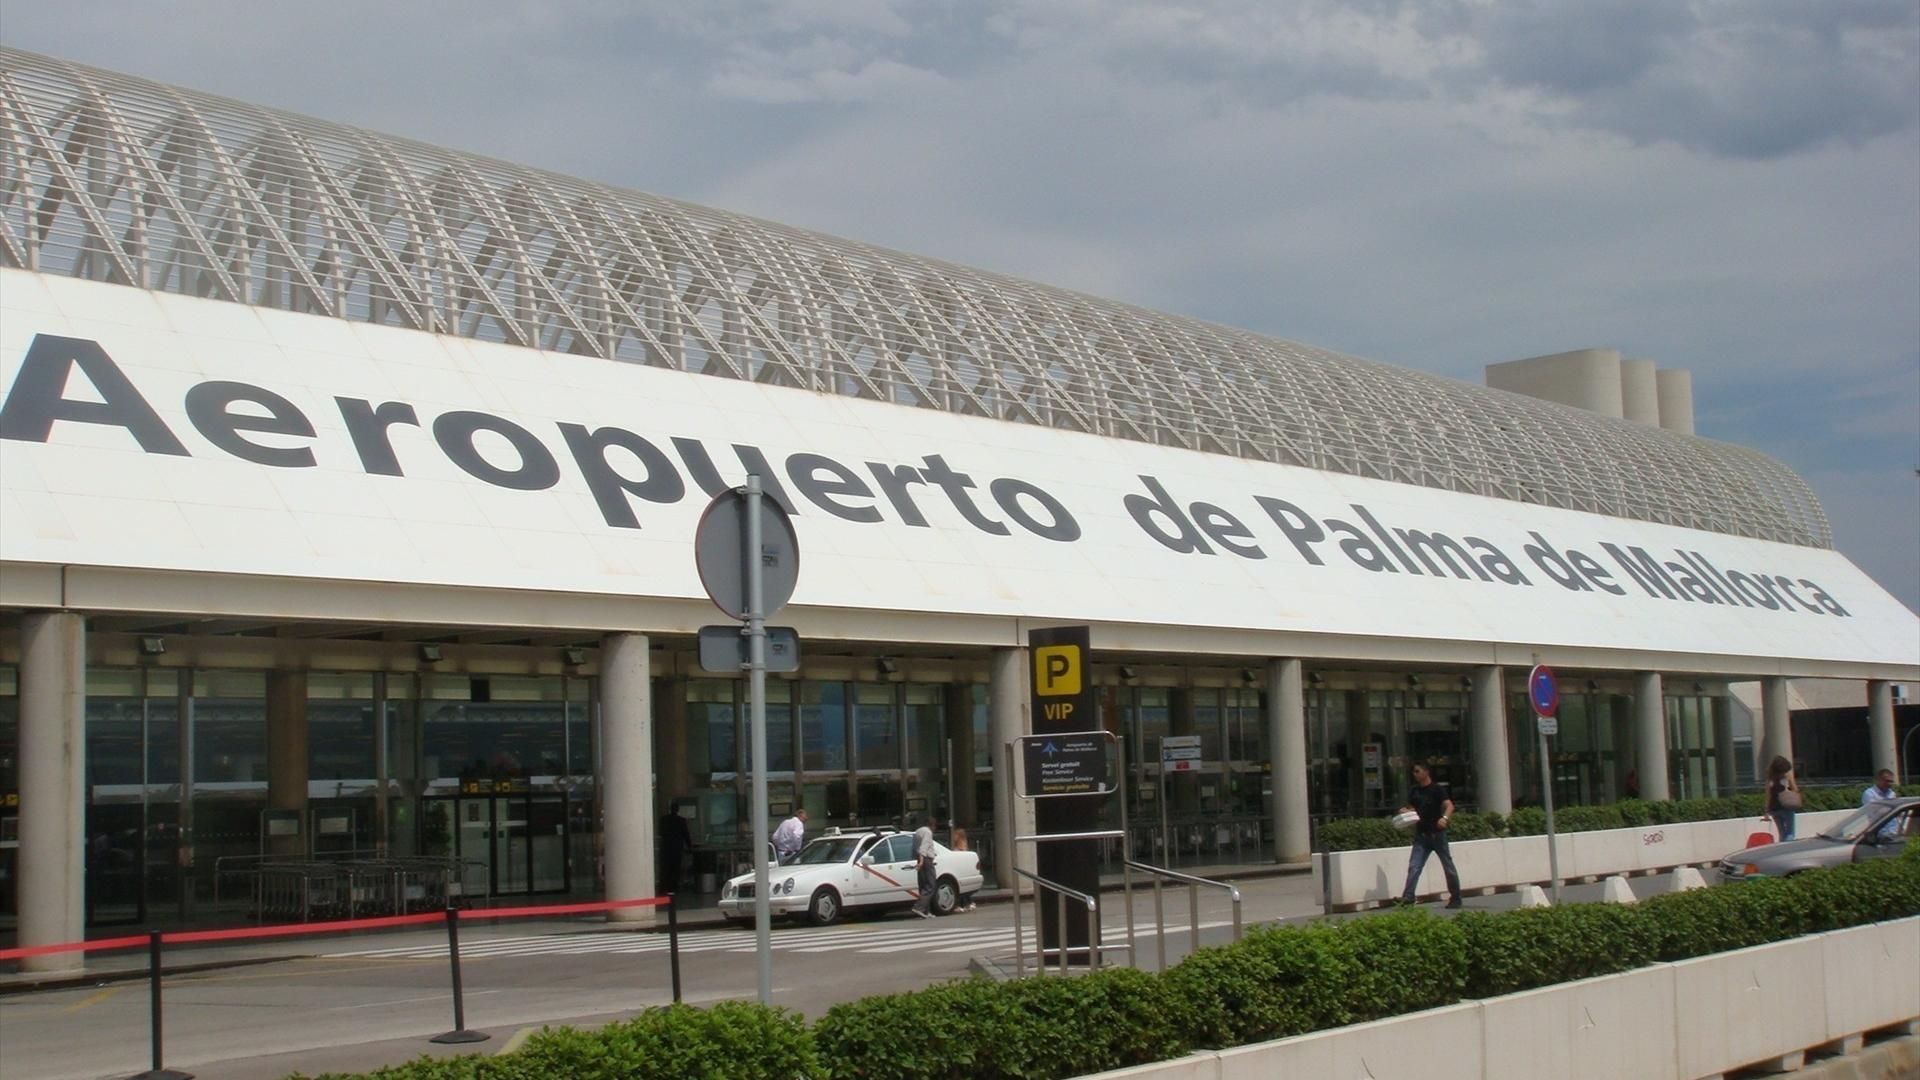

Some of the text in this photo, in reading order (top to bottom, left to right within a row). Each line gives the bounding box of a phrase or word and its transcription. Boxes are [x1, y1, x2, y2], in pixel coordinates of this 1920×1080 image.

[0, 333, 1852, 617] Aeropuerto de Palma de Mallorca
[1047, 654, 1070, 688] P
[1044, 703, 1073, 720] VIP
